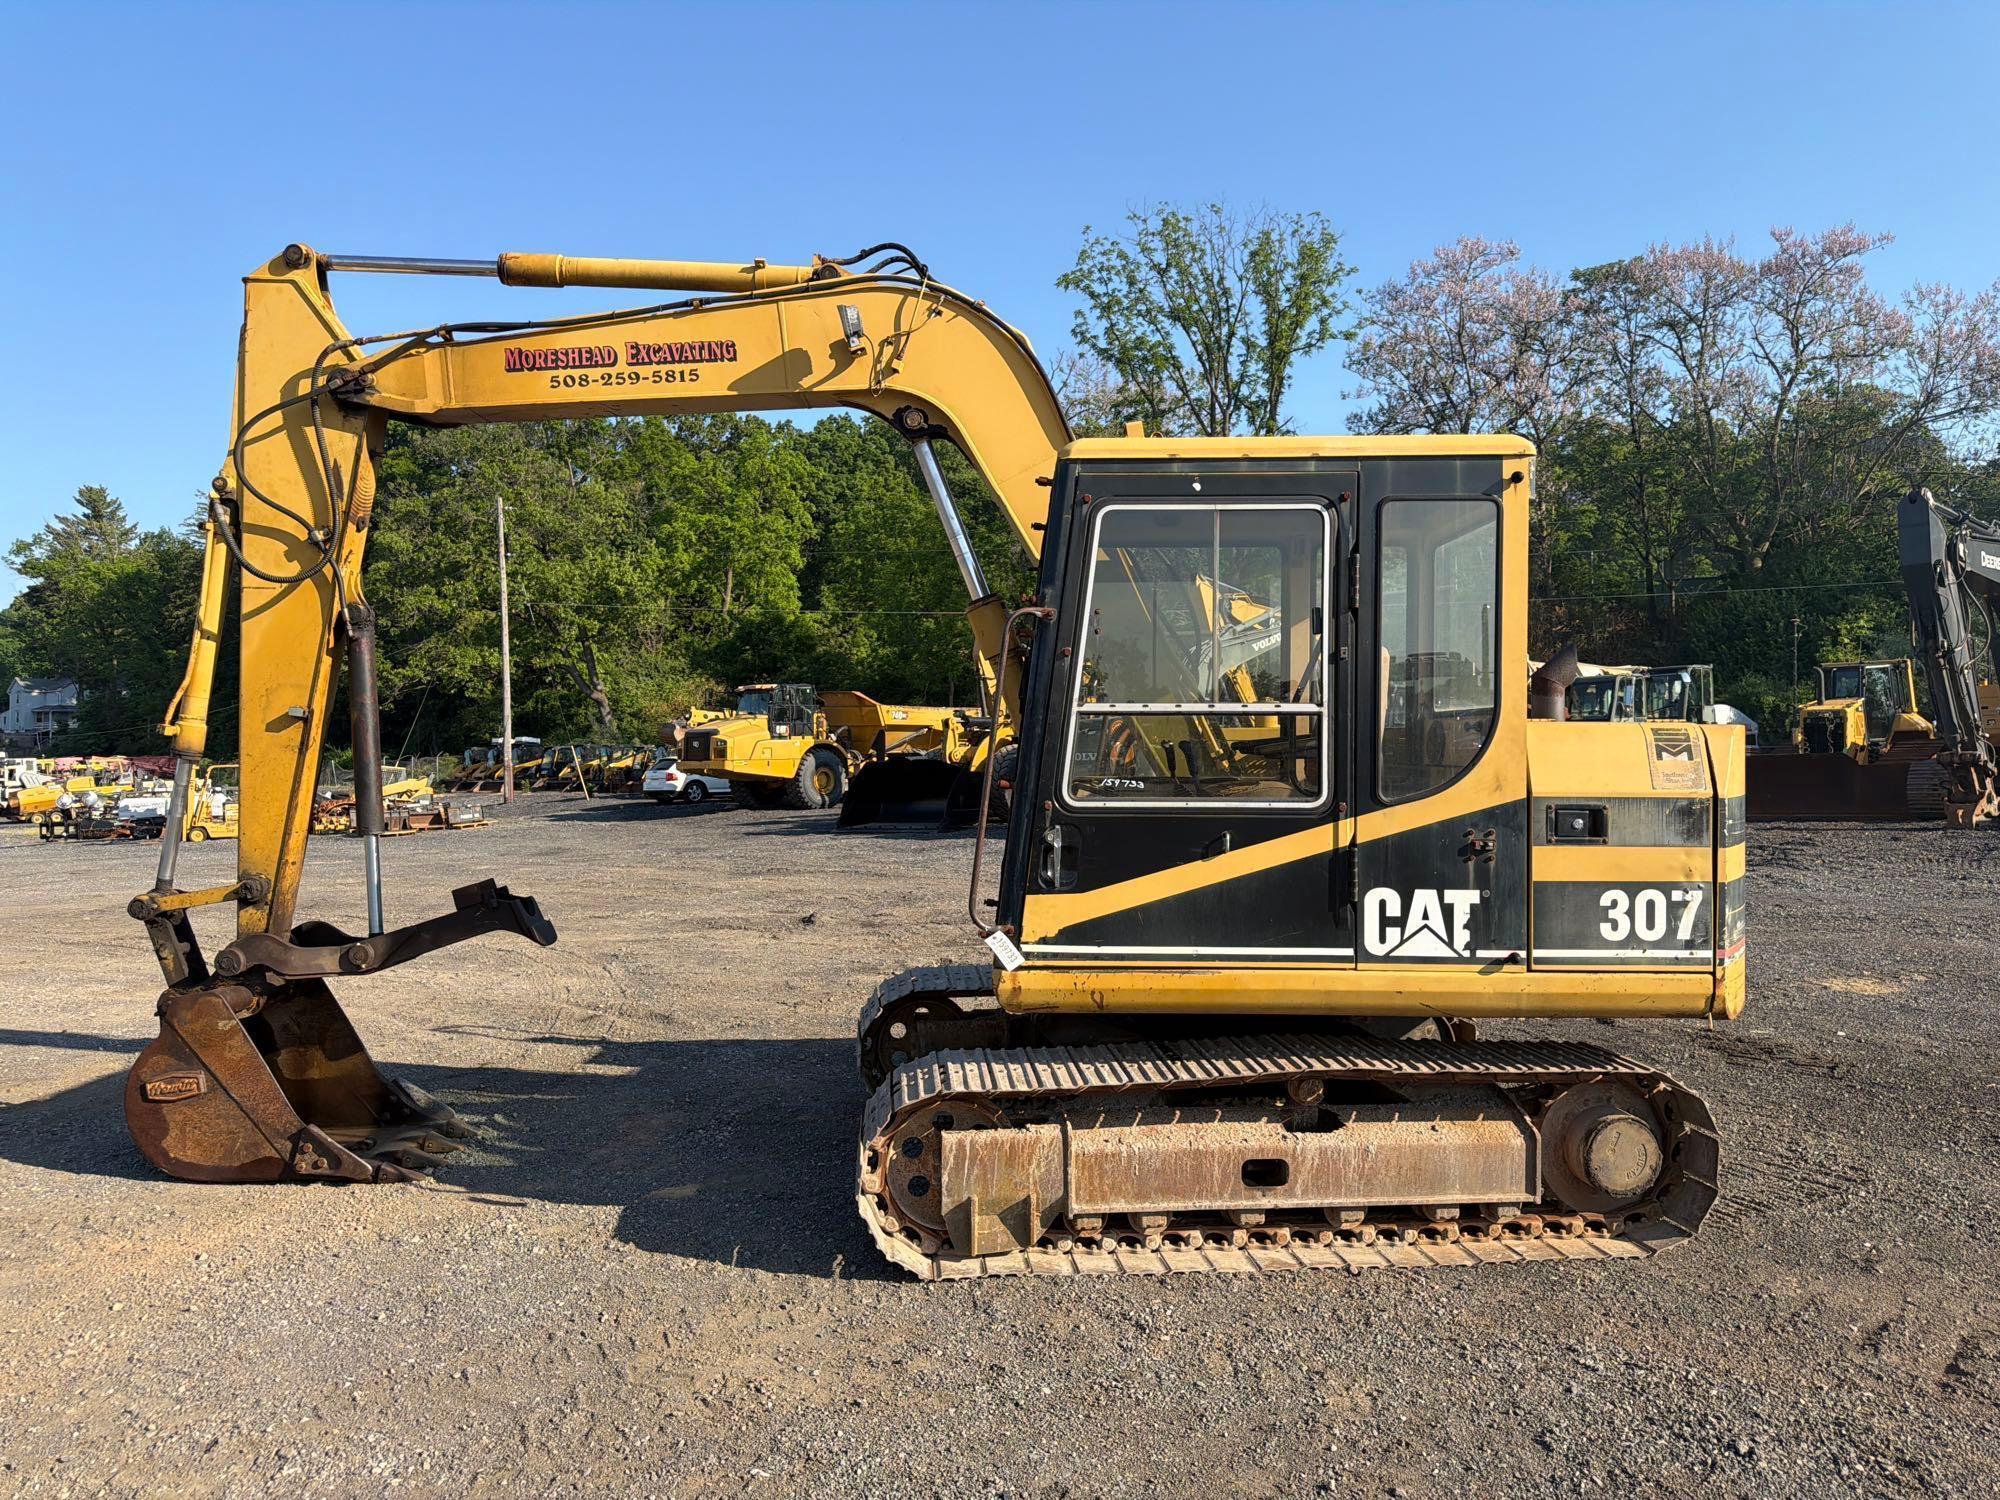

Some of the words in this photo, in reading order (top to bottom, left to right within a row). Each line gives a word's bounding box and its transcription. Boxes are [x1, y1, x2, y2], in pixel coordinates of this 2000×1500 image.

[504, 346, 618, 372] MORESHEAD
[625, 340, 737, 366] EXCAVATING
[550, 368, 700, 389] 508-259-5815
[1101, 778, 1145, 789] 159733
[1364, 887, 1480, 957] CAT
[1599, 888, 1703, 942] 307
